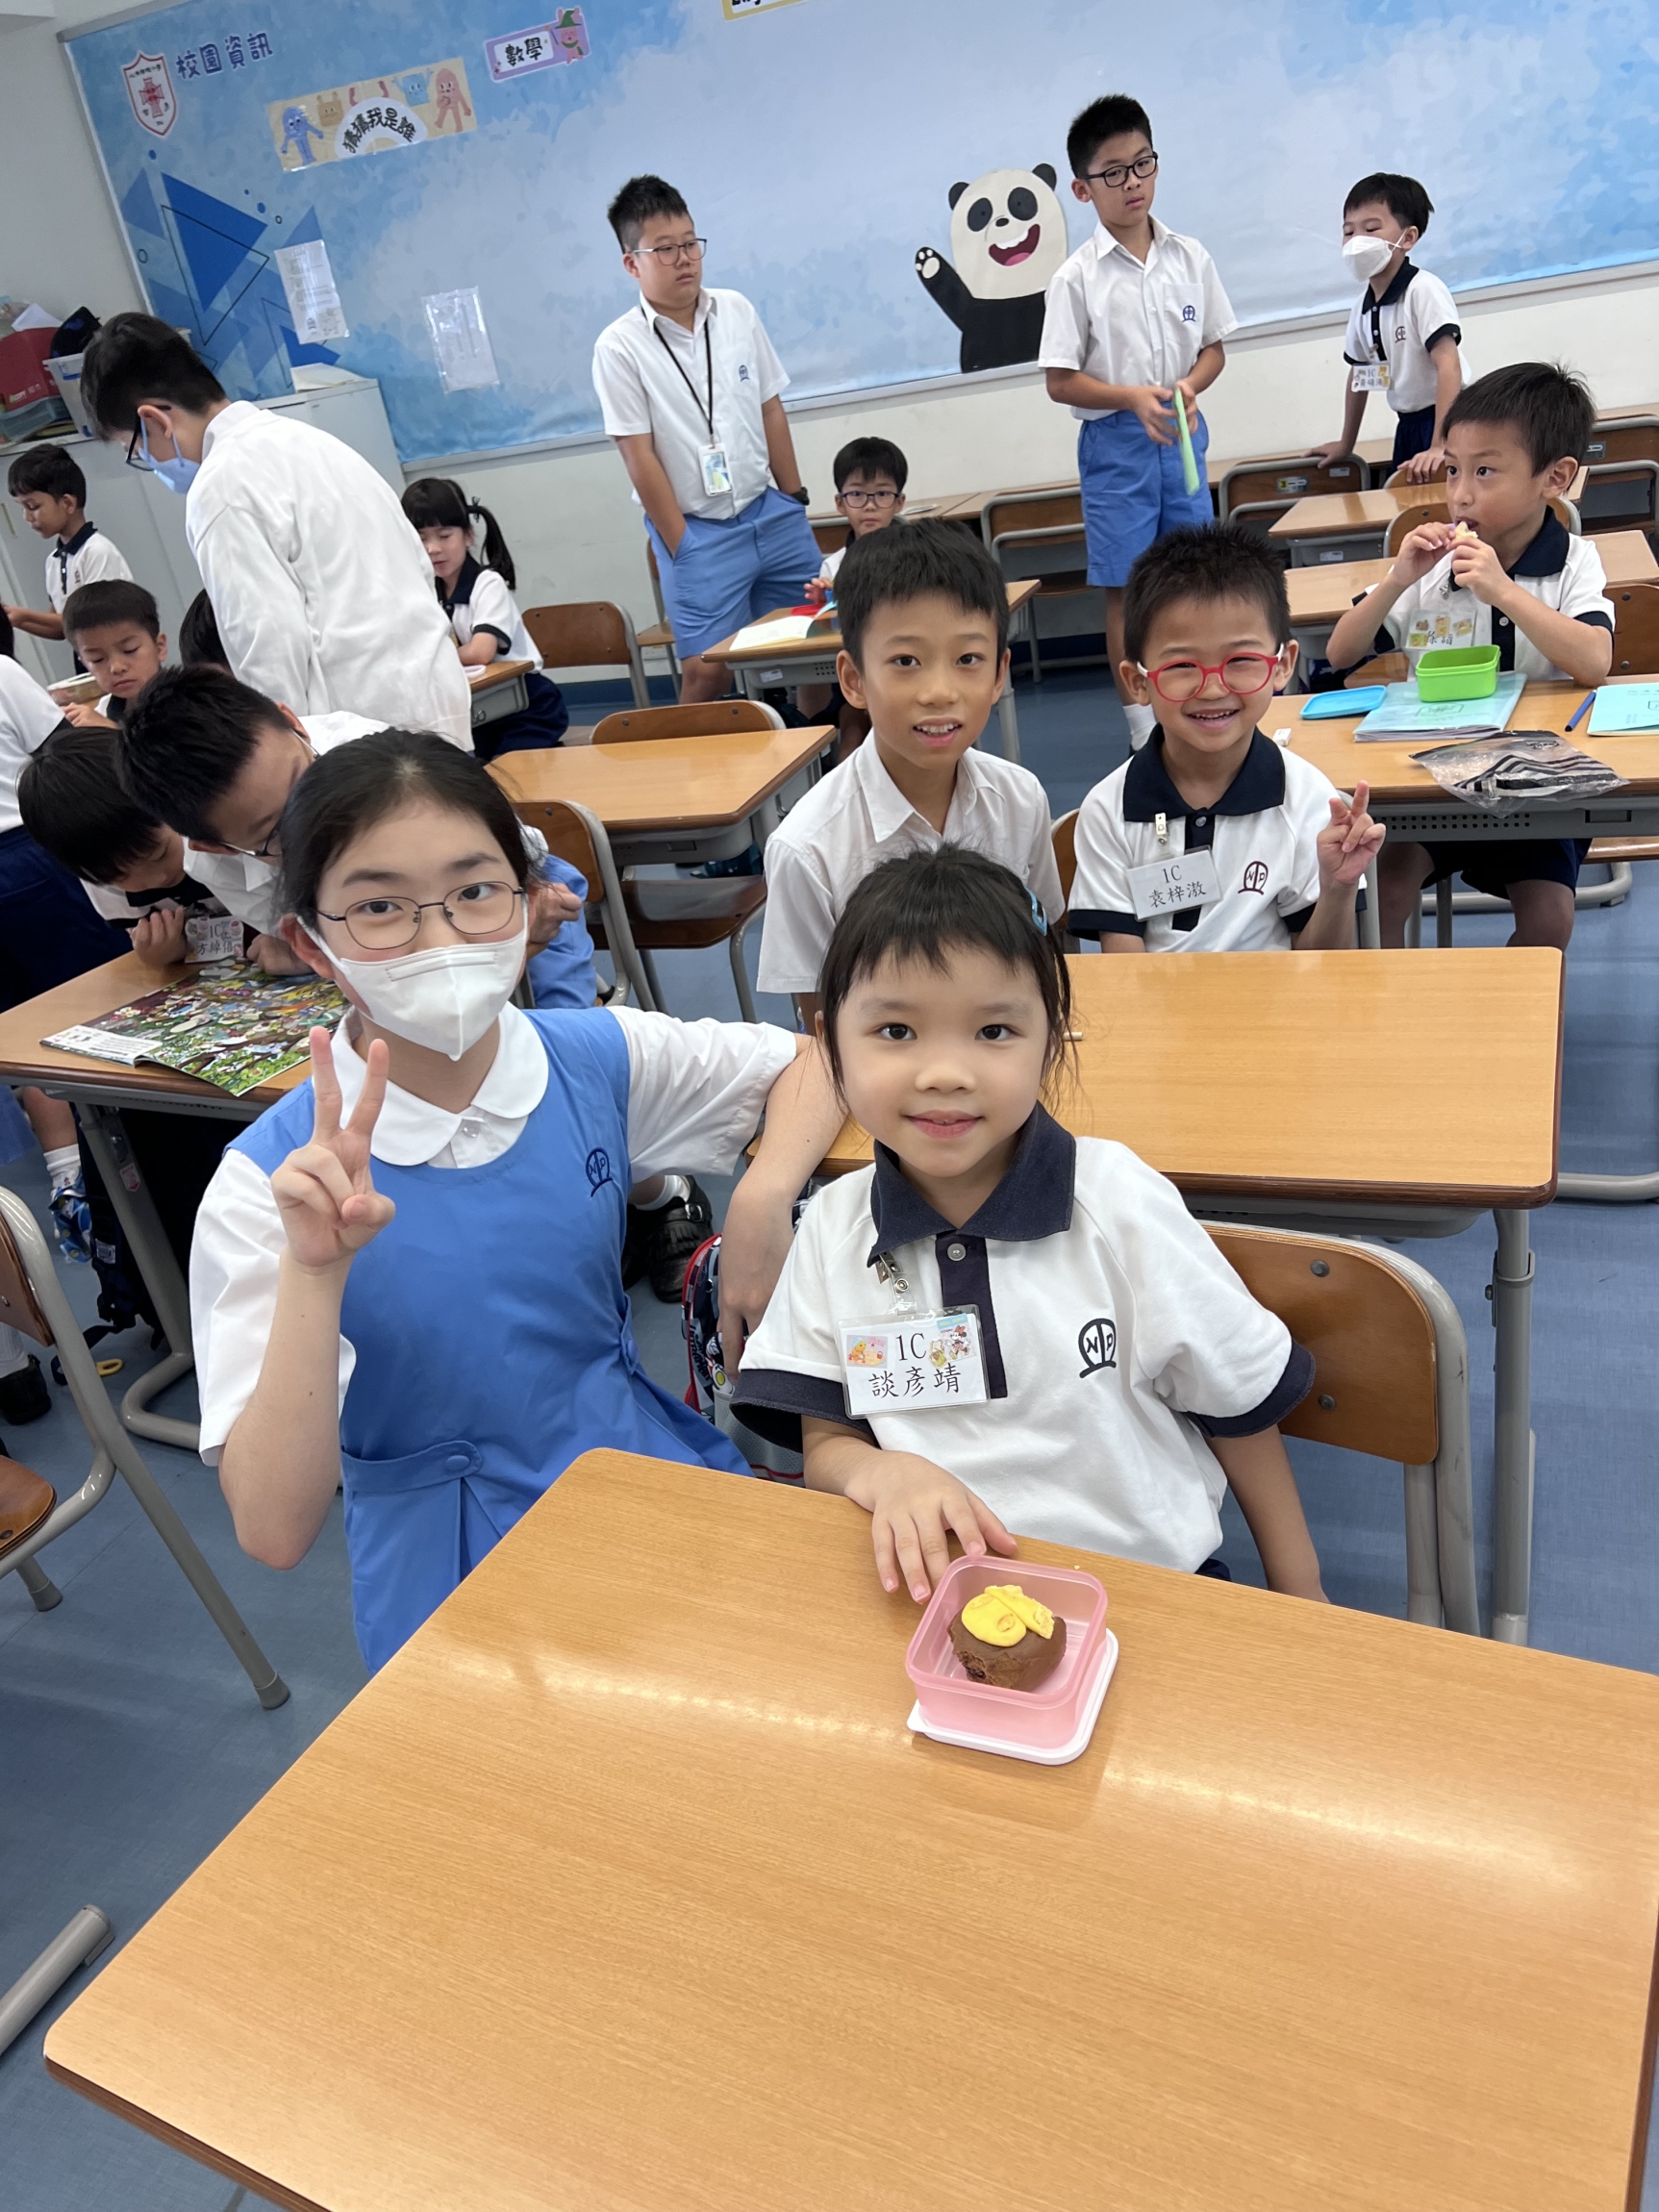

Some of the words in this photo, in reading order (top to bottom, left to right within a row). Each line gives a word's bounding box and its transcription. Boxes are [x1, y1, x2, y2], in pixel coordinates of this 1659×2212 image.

[176, 33, 273, 79] 校園資訊
[505, 37, 543, 67] 數學
[342, 107, 416, 154] 猜猜我是誰
[1162, 865, 1182, 884] 1C
[895, 1332, 927, 1362] 1C
[868, 1362, 961, 1399] 談彥靖
